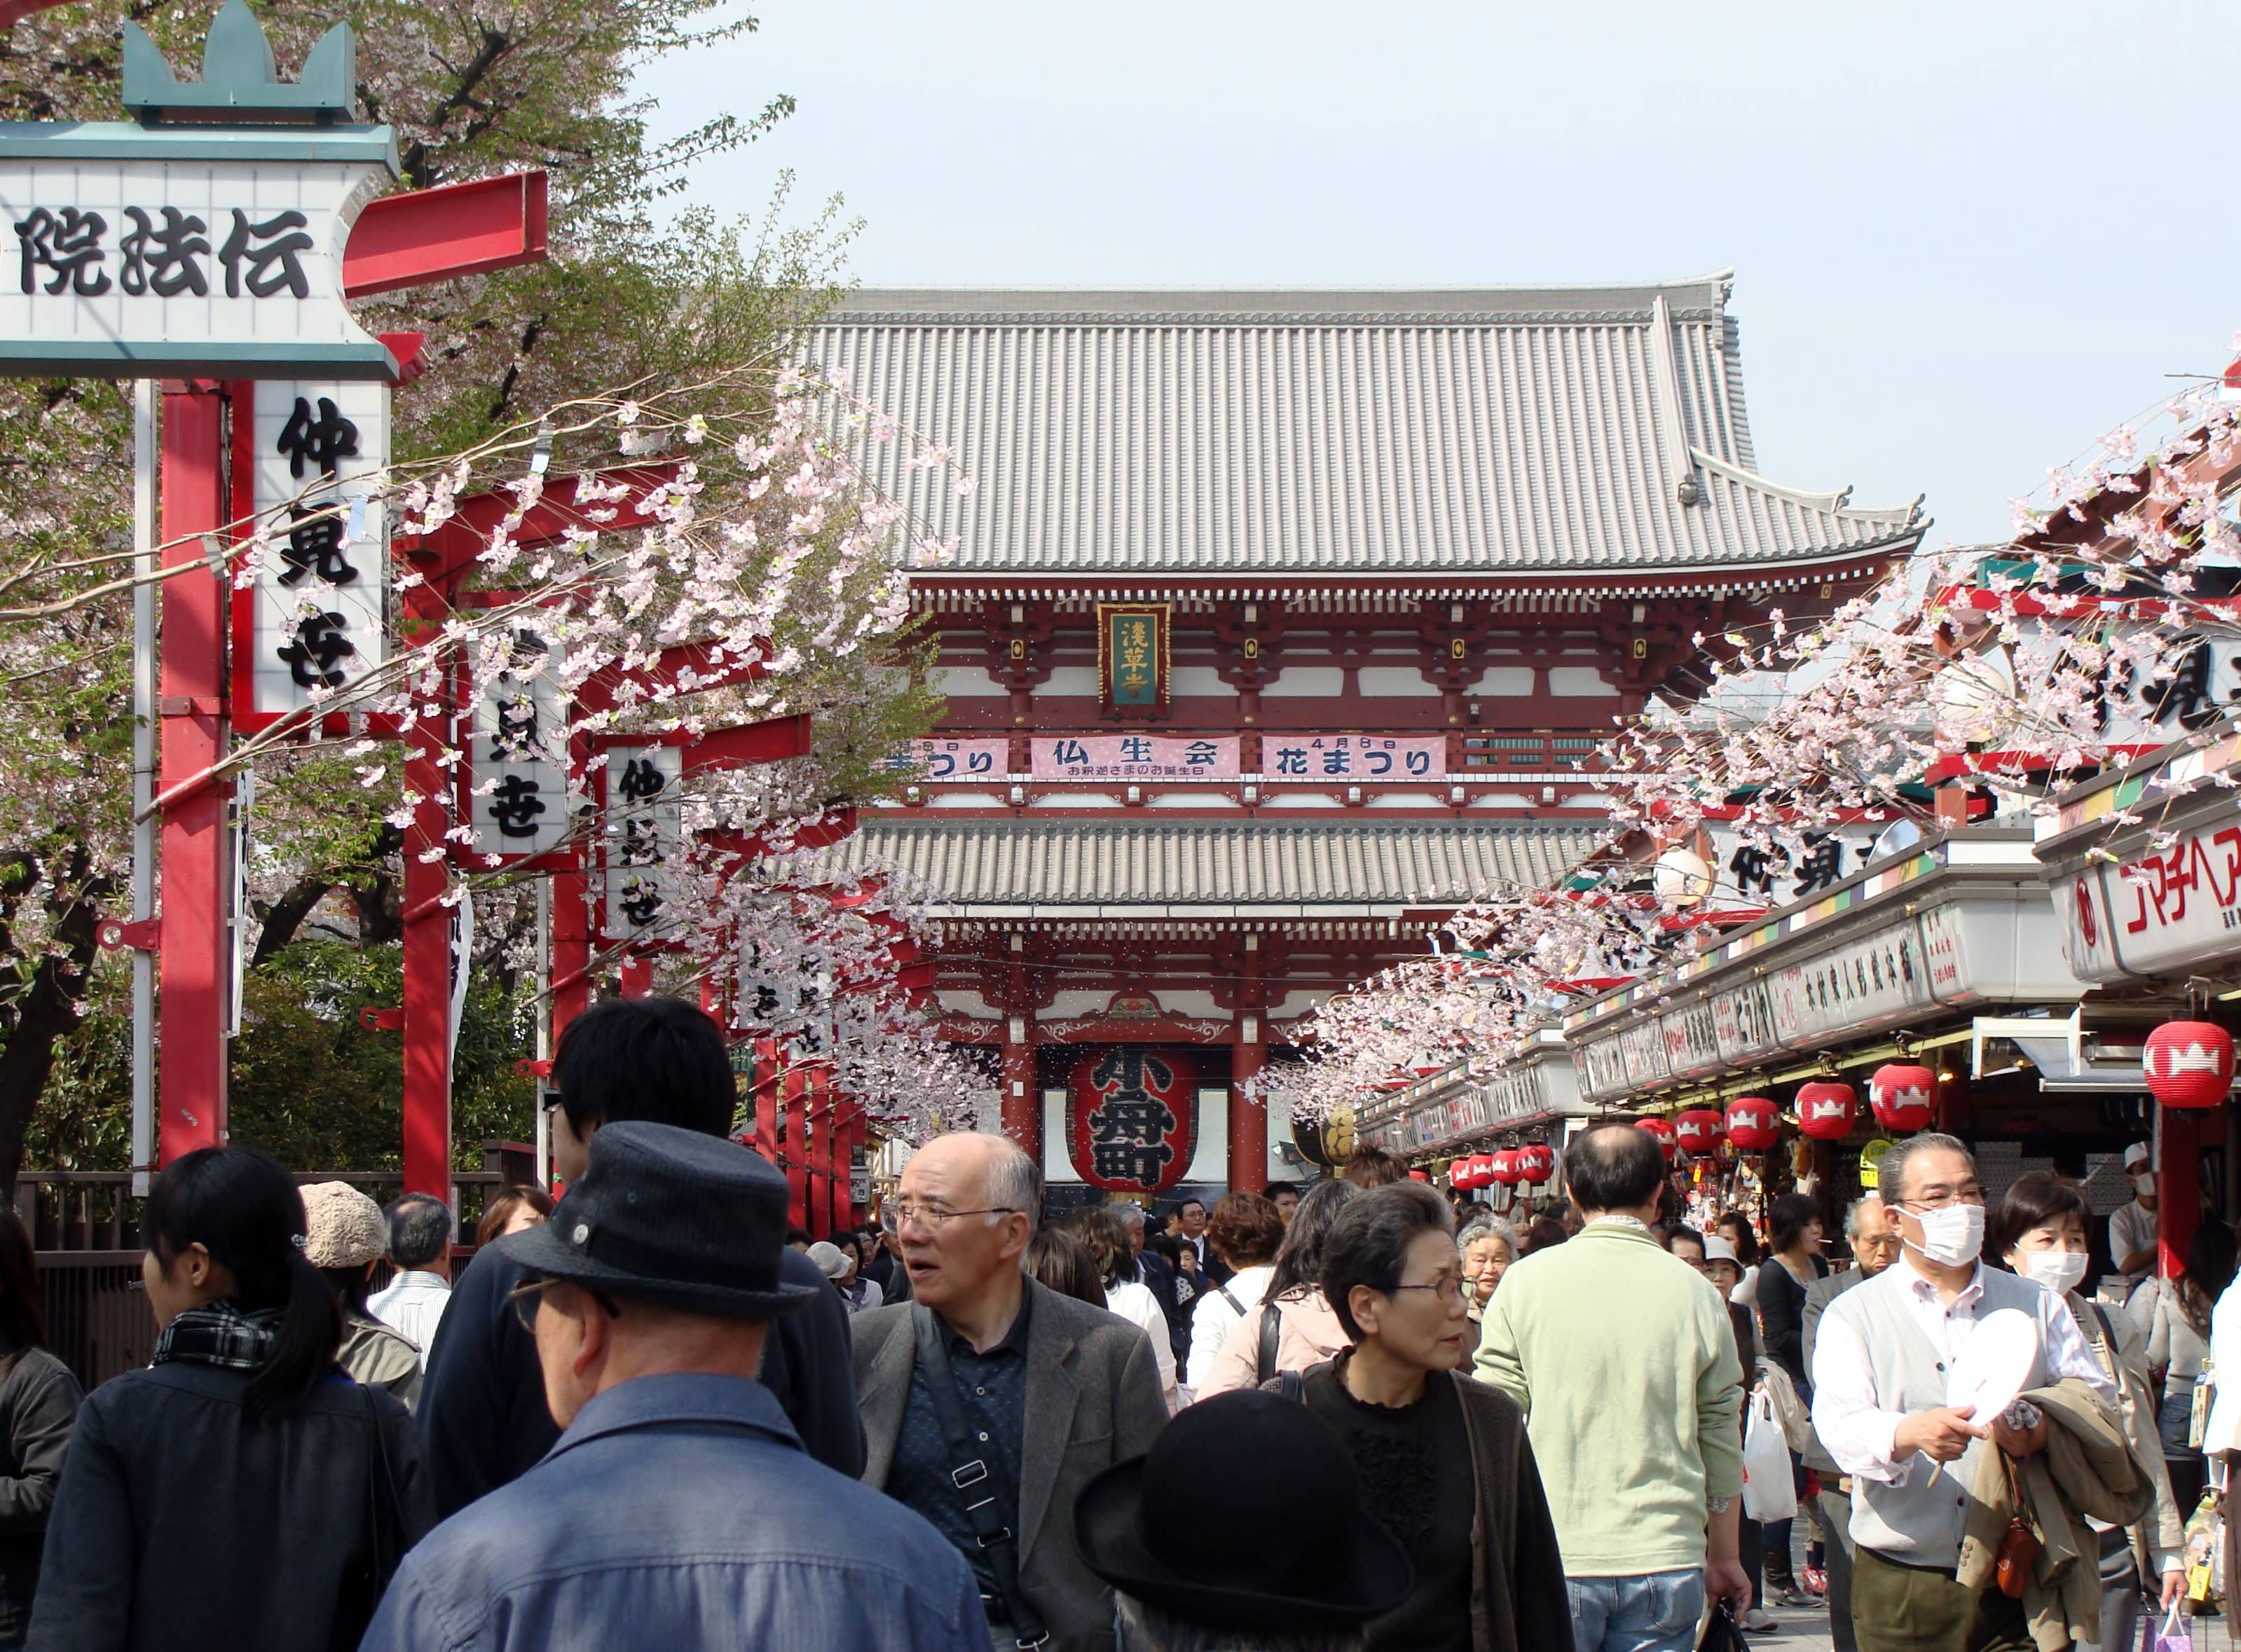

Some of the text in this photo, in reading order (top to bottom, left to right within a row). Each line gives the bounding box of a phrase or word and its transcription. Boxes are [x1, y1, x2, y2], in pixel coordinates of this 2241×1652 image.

[276, 397, 359, 689] 仲見世
[1053, 737, 1219, 765] 仏生会
[1311, 737, 1396, 750] 4月8日
[1067, 764, 1205, 776] お釈迦さまのお誕生日
[1276, 748, 1431, 776] 花まつり
